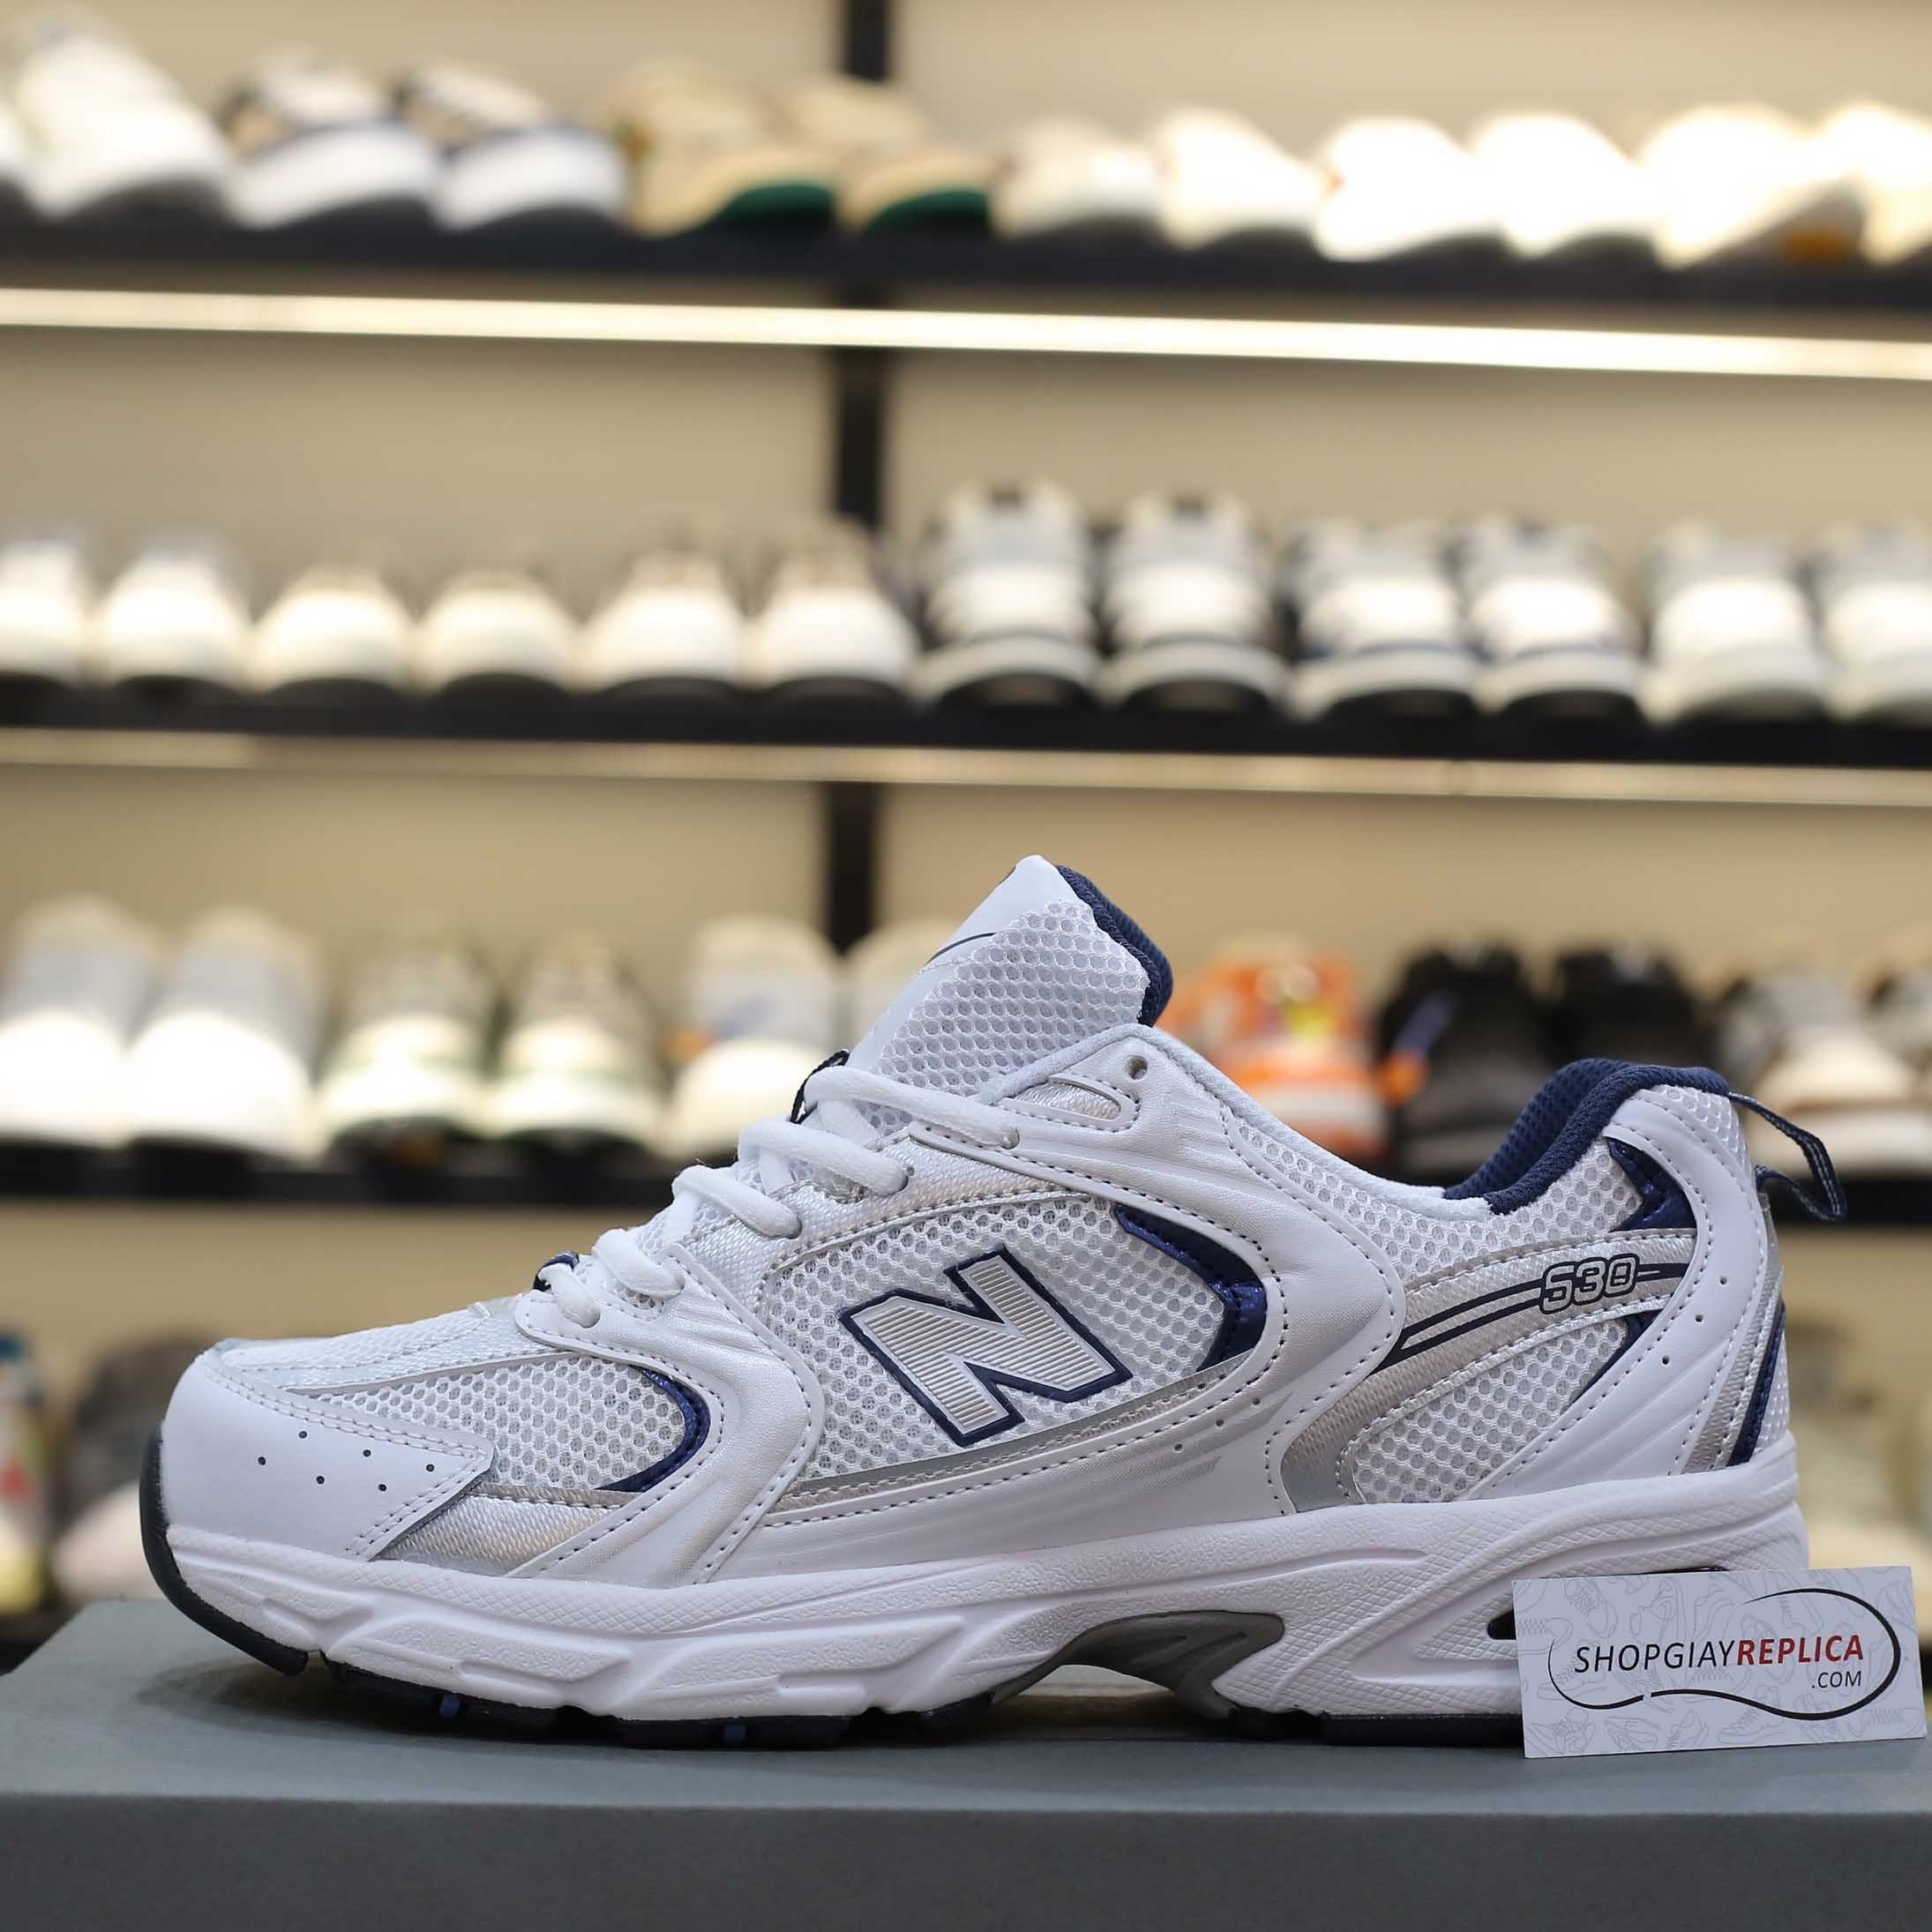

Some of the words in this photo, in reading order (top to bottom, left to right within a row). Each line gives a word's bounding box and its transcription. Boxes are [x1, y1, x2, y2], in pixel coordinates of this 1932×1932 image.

[1539, 1254, 1639, 1314] 530
[839, 1244, 1133, 1447] N
[1811, 1670, 1861, 1689] .COM
